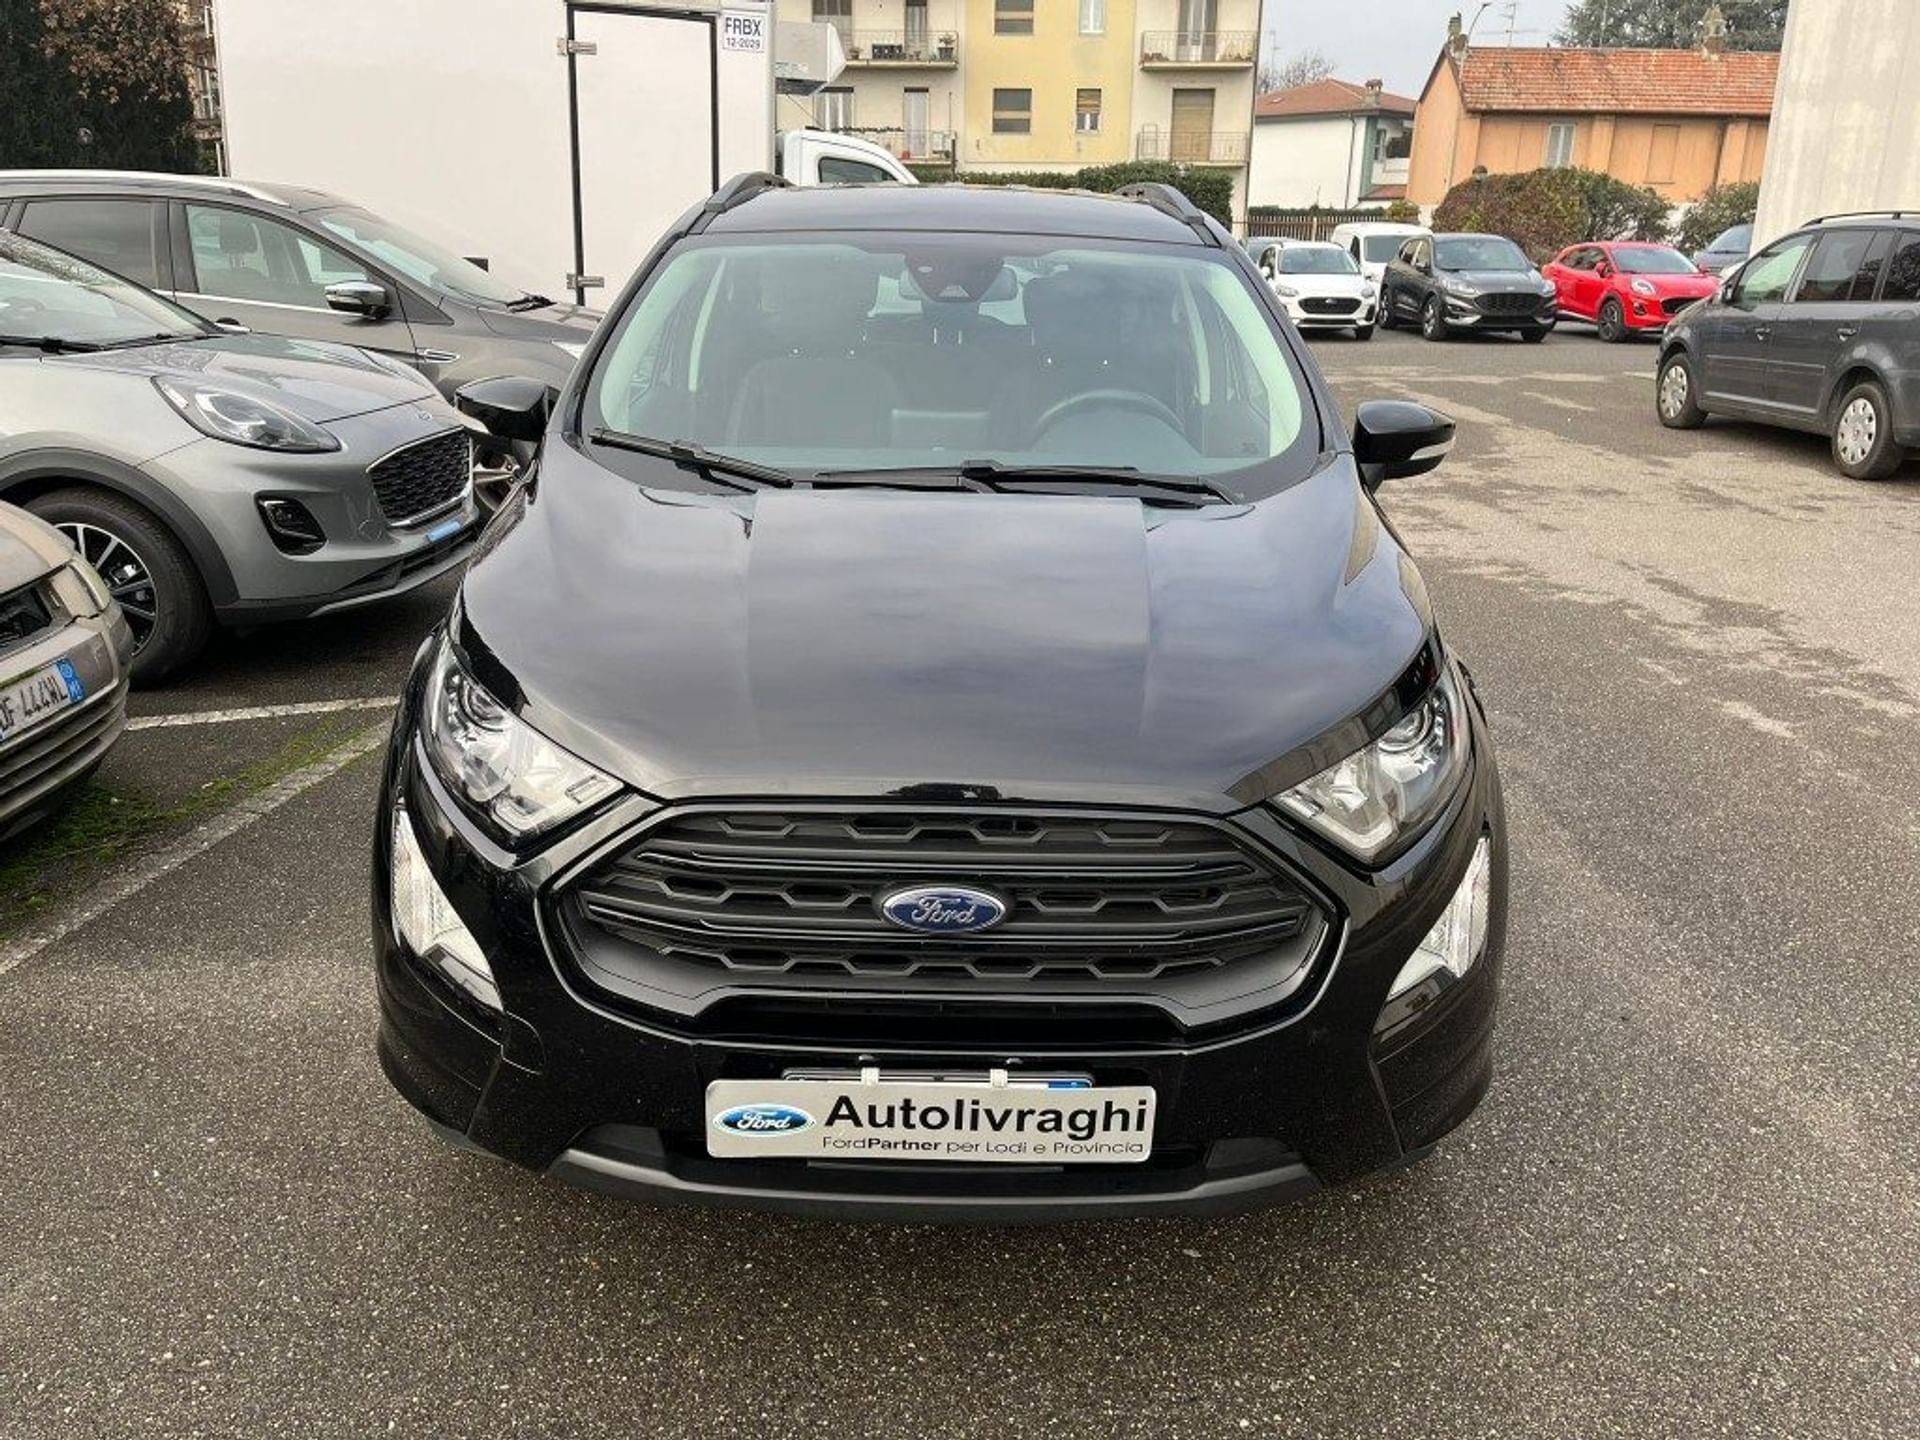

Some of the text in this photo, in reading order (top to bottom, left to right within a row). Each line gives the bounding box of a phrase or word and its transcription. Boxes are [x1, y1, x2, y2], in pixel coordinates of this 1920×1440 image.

[725, 16, 762, 37] FRBX
[910, 895, 978, 924] Ford
[736, 1110, 792, 1130] Ford
[824, 1095, 1148, 1142] Autolivraghi
[822, 1136, 1145, 1155] FordPartner per Lodi e Provincia
